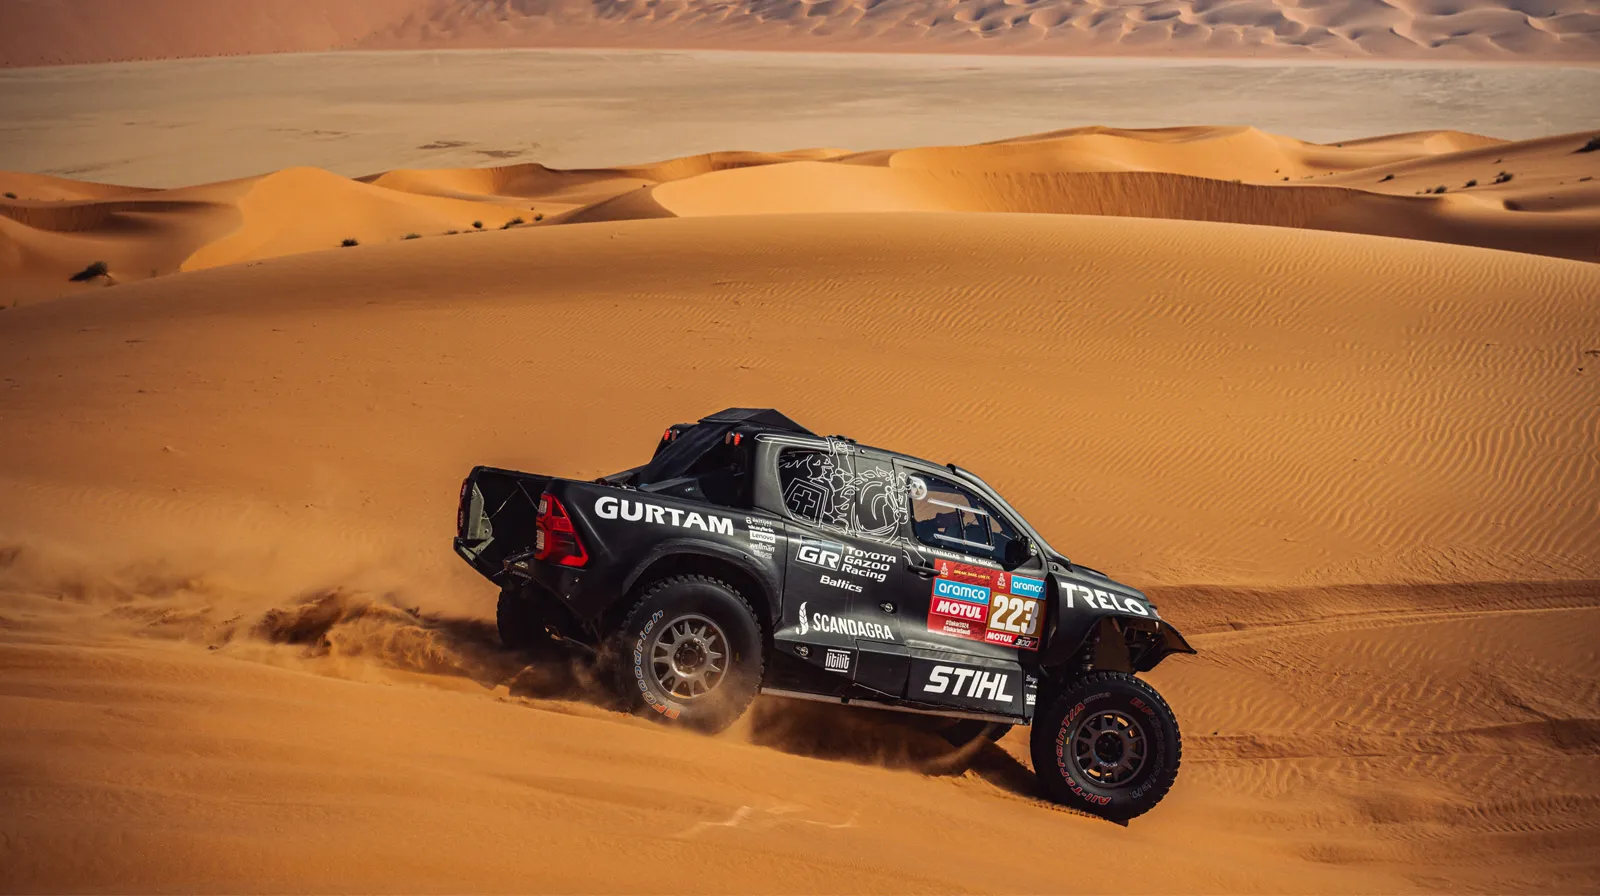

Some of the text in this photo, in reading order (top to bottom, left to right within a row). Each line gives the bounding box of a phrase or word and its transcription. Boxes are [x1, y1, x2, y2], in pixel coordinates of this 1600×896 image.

[594, 496, 734, 536] GURTAM
[751, 532, 774, 541] Lenovo
[798, 546, 840, 569] GR
[844, 555, 891, 571] GAZOO
[846, 546, 897, 563] TOYOTA
[841, 563, 887, 582] Racing
[820, 575, 863, 593] Baltics
[938, 582, 986, 600] aramco
[1013, 581, 1044, 593] aramco
[1060, 582, 1148, 616] TRELO
[936, 600, 982, 619] MOTUL
[990, 595, 1039, 634] 223
[813, 613, 895, 640] SCANDAGRA
[986, 632, 1013, 642] MOTUL
[923, 665, 1014, 702] STIHL
